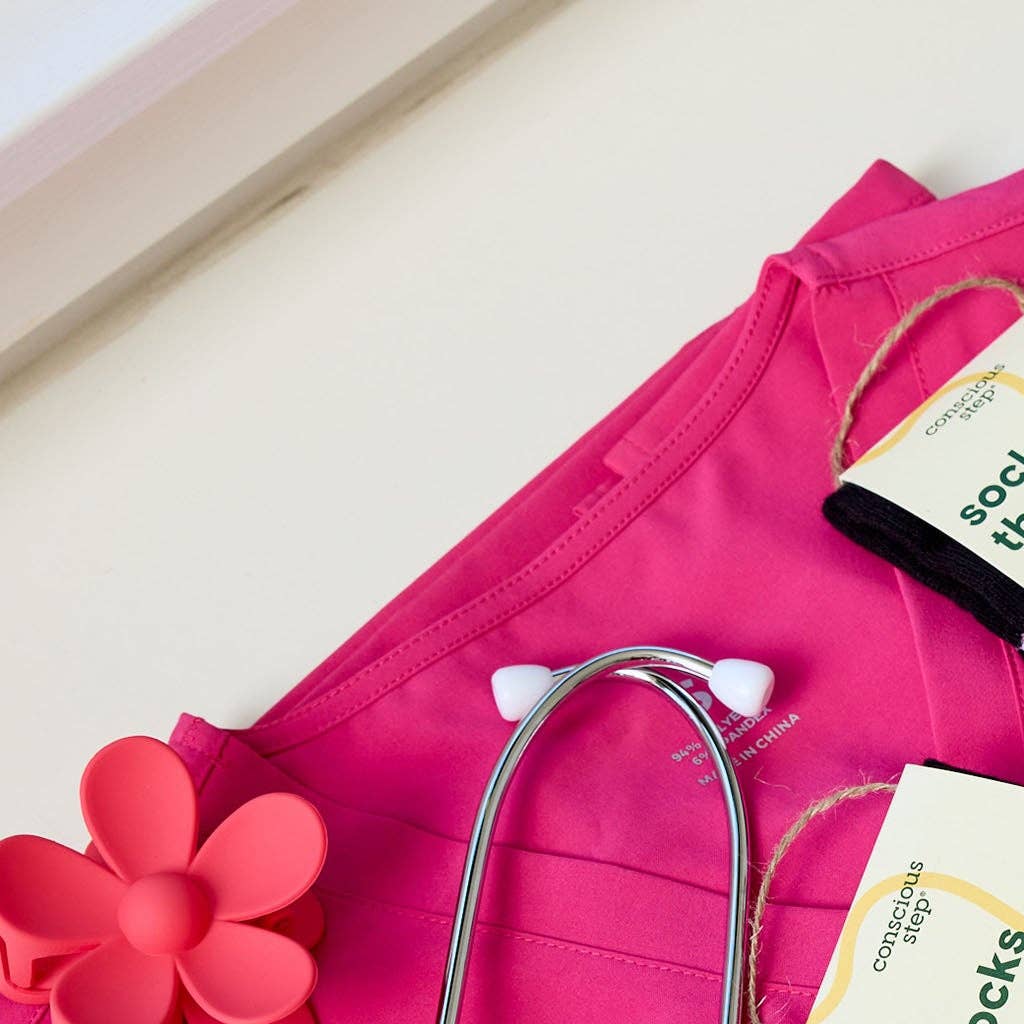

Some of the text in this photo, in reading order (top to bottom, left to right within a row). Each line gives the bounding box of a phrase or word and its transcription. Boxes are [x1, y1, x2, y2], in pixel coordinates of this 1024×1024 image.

[925, 363, 1005, 436] conscious
[671, 742, 702, 762] 94%
[739, 746, 758, 761] IN
[756, 713, 800, 749] CHINA
[873, 860, 923, 972] conscious
